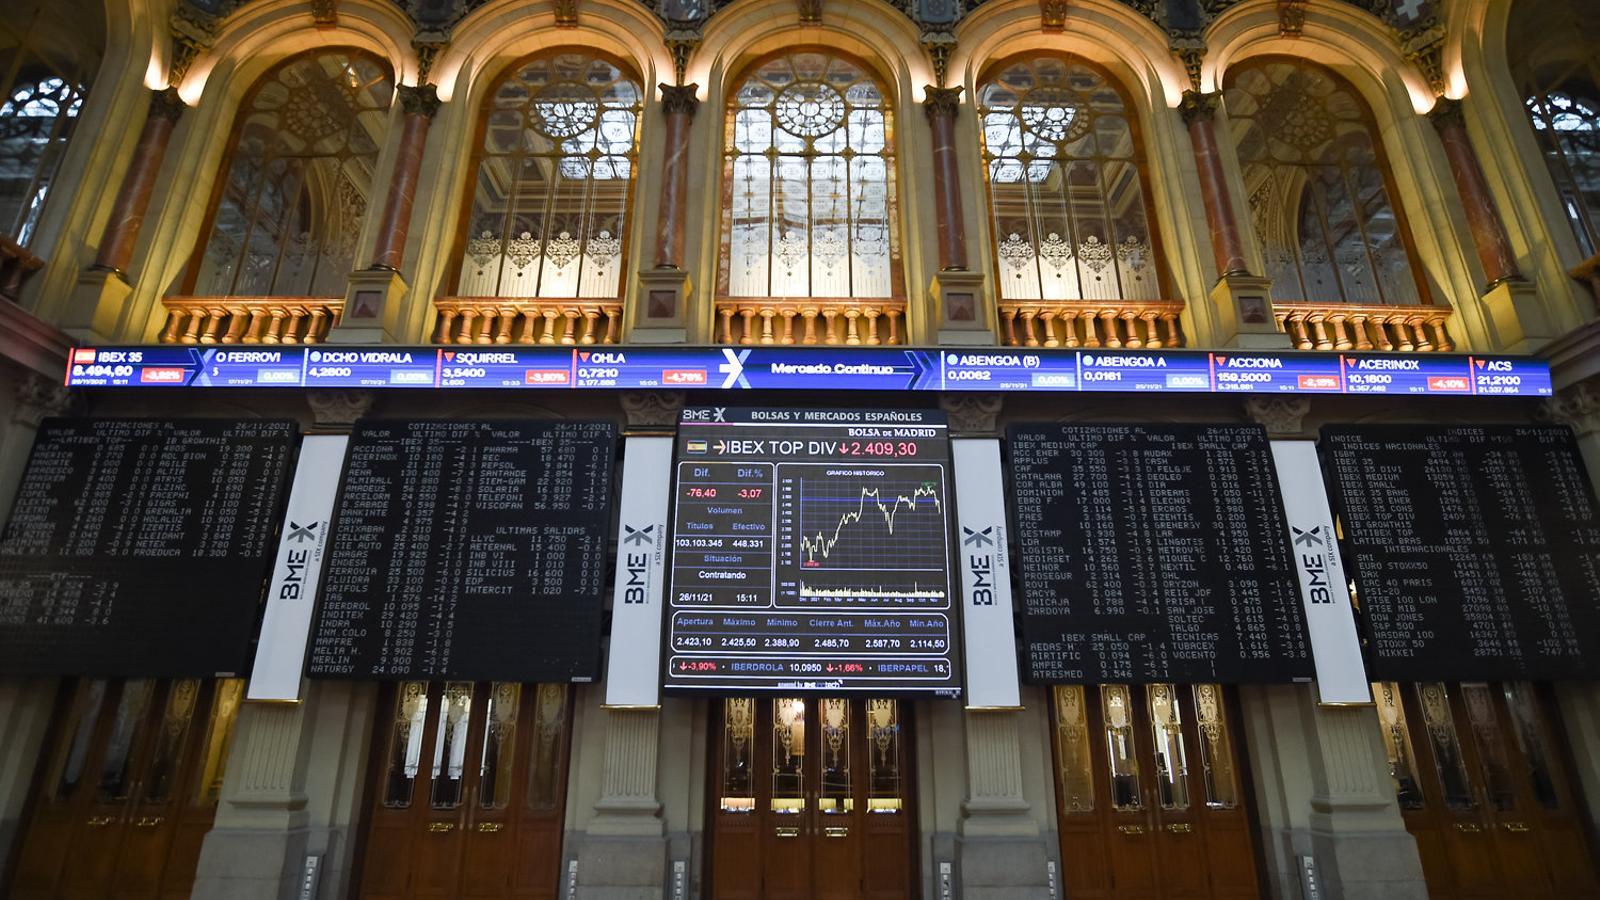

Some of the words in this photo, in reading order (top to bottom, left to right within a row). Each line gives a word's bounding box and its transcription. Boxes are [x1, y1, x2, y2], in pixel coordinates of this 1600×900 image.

[98, 352, 126, 362] IBEX
[128, 352, 142, 362] 35
[228, 352, 281, 362] FERROVI
[322, 352, 358, 363] DCHO
[360, 352, 412, 363] VIDRALA
[456, 353, 518, 365] SQUIRREL
[592, 353, 626, 364] OHLA
[960, 356, 1021, 366] ABENGOA
[1023, 356, 1040, 368] (B)
[1095, 357, 1156, 367] ABENGOA
[1156, 357, 1166, 367] A
[1228, 358, 1282, 368] ACCIONA
[1358, 360, 1420, 370] ACERINOX
[1487, 361, 1512, 372] ACS
[442, 368, 486, 378] 3,5400
[578, 368, 618, 378] 0,7210
[771, 363, 832, 374] Mercado
[834, 363, 894, 374] Continuo
[948, 370, 991, 380] 0,0062
[1084, 372, 1122, 382] 0,0161
[1217, 372, 1272, 383] 159,5000
[1477, 376, 1520, 386] 21,2100
[683, 410, 710, 420] BME
[752, 412, 790, 420] BOLSAS
[794, 412, 801, 420] Y
[804, 412, 860, 420] MERCADOS
[866, 412, 922, 421] ESPAÑOLES
[848, 428, 880, 436] BOLSA
[894, 428, 936, 438] MADRID
[726, 441, 764, 454] IBEX
[769, 441, 804, 454] TOP
[808, 442, 837, 454] DIV
[852, 442, 917, 458] 2.409,30
[694, 468, 710, 477] Dif.
[738, 468, 764, 478] Dif.%
[686, 488, 716, 498] -76,40
[738, 488, 762, 498] -3,07
[476, 502, 524, 510] VISCOFAN
[708, 506, 743, 514] Volumen
[732, 522, 766, 530] Efectivo
[280, 550, 308, 600] BME
[624, 553, 647, 604] BME
[699, 570, 747, 580] Contratando
[970, 554, 992, 606] BME
[1302, 554, 1331, 604] BME
[464, 586, 513, 594] INTERCIT
[679, 593, 713, 602] 26/11/21
[736, 594, 758, 602] 15:11
[1026, 598, 1070, 606] UNICAJA
[1027, 607, 1071, 616] ZARDOYA
[676, 618, 714, 626] Apertura
[810, 618, 836, 627] Cierre
[838, 618, 854, 628] Ant.
[1170, 633, 1220, 641] TECNICAS
[676, 638, 712, 646] 2.423,10
[722, 638, 756, 647] 2.425,50
[764, 638, 800, 648] 2.388,90
[814, 639, 850, 648] 2.485,70
[866, 639, 900, 648] 2.587,70
[910, 640, 945, 648] 2.114,50
[1173, 651, 1216, 660] VOCENTO
[688, 662, 717, 671] -3,90%
[731, 663, 784, 672] IBERDROLA
[790, 664, 822, 672] 10,0950
[835, 664, 864, 672] -1,66%
[878, 664, 928, 672] IBERPAPEL
[1033, 670, 1083, 678] ATRESMED
